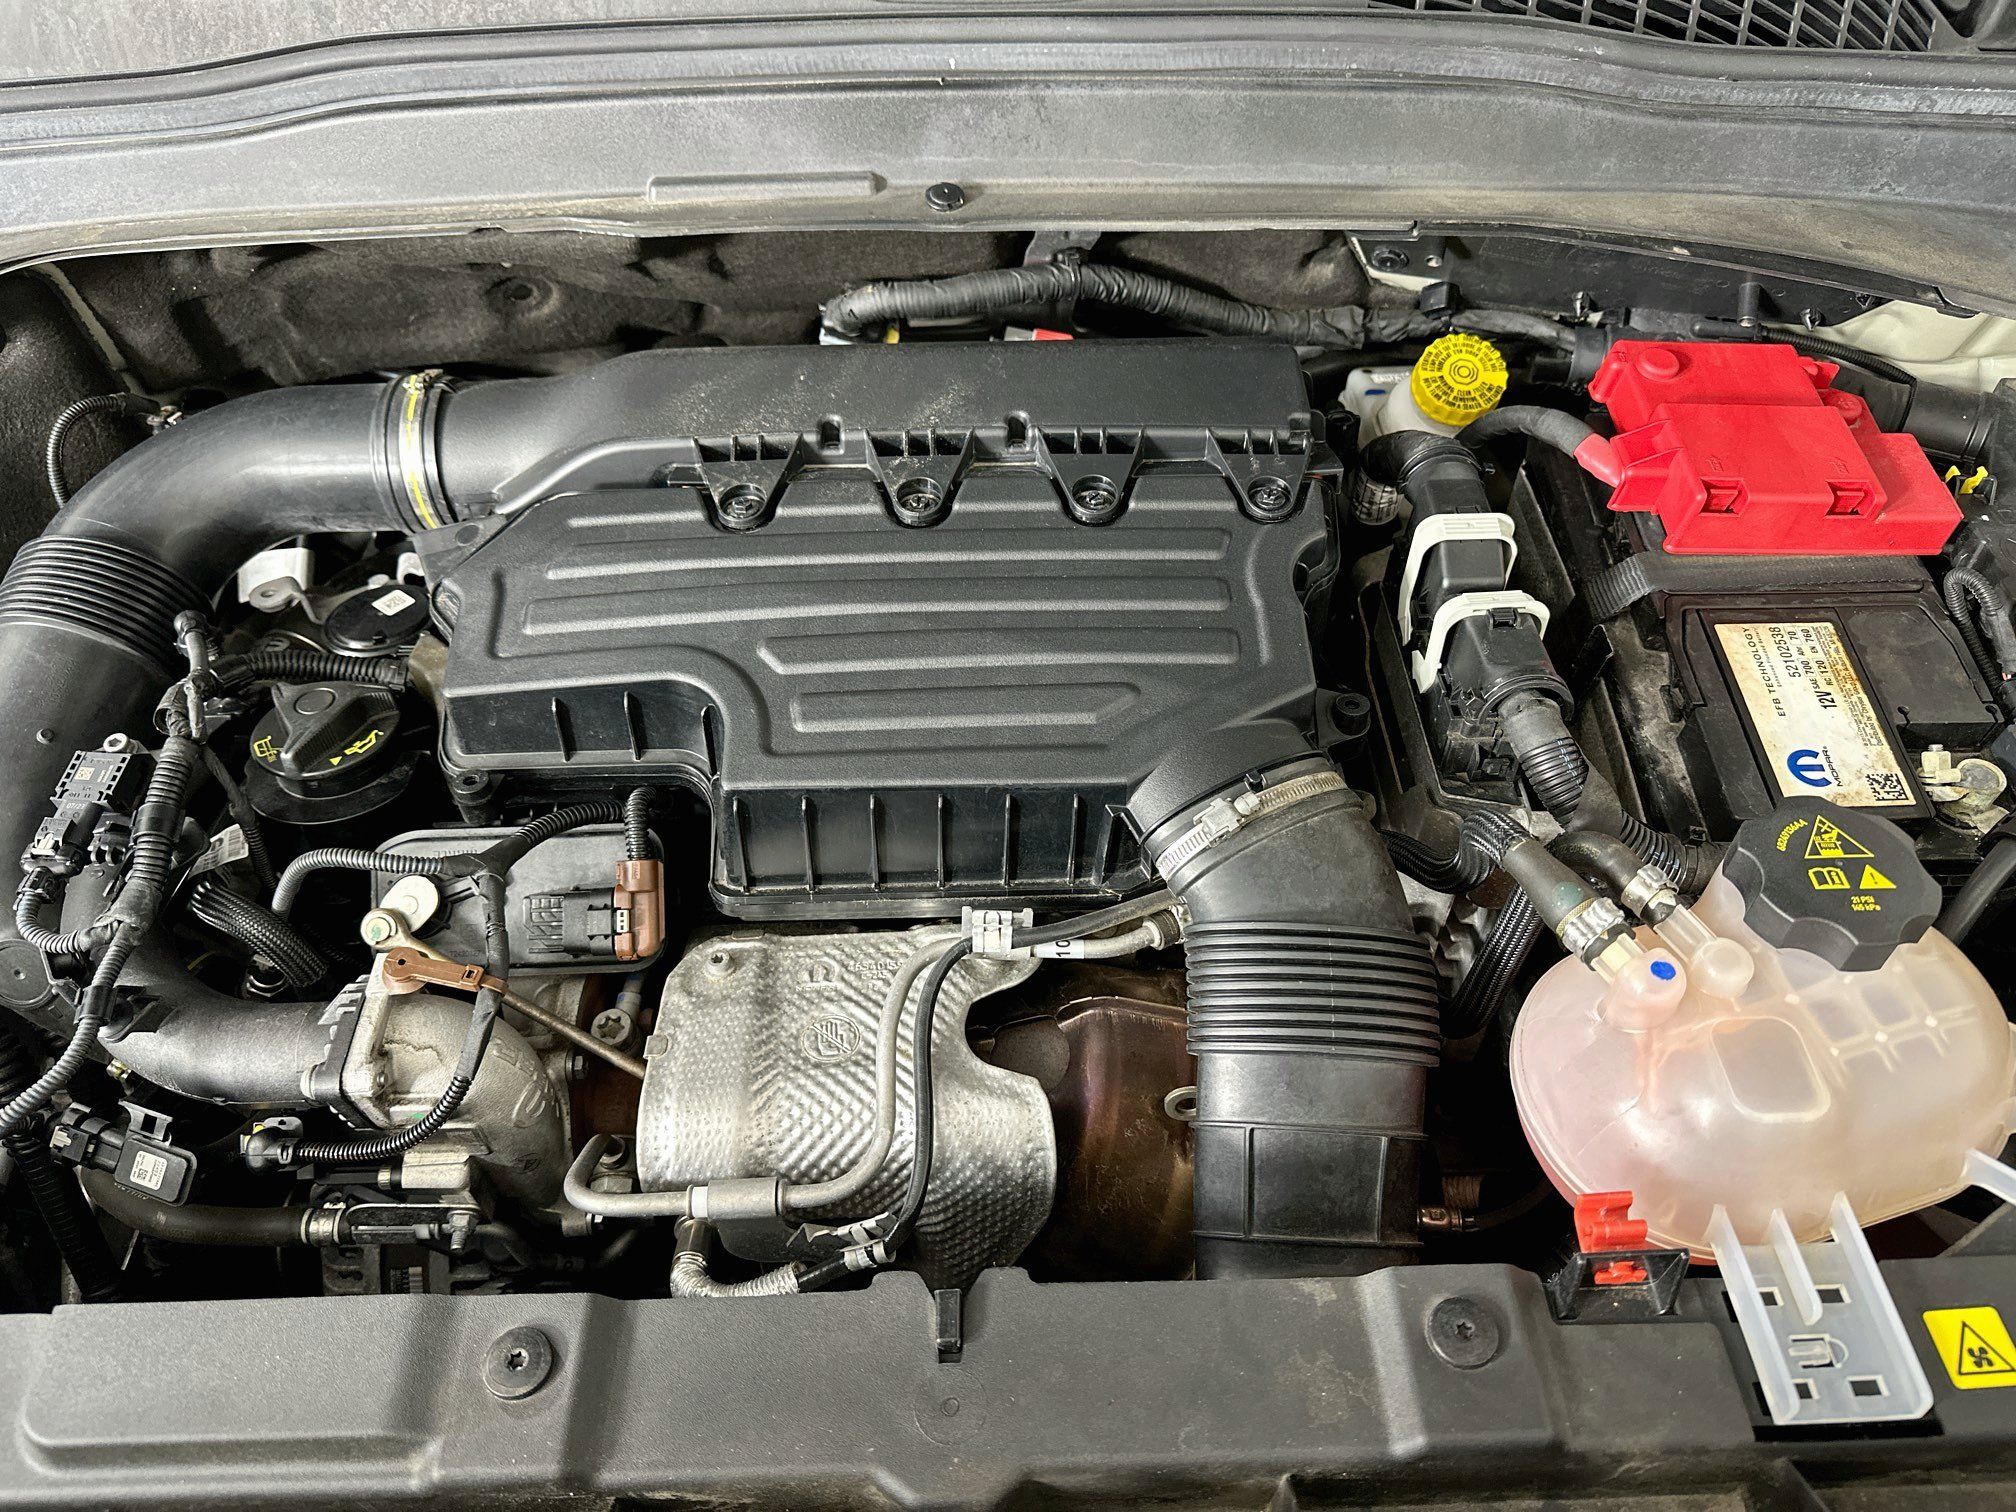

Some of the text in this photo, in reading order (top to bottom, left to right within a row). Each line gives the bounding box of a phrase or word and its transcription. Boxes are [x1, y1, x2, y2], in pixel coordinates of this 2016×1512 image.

[1787, 631, 1799, 641] 70
[1801, 628, 1815, 643] 760
[1768, 626, 1802, 678] 52102538
[1810, 645, 1819, 654] EN
[1742, 626, 1786, 717] EFB TECHNOLOGY
[1801, 660, 1815, 675] 700
[1815, 660, 1829, 675] 120
[1810, 678, 1820, 690] SAE
[1814, 690, 1838, 710] 12V
[1860, 895, 1875, 904] PSI
